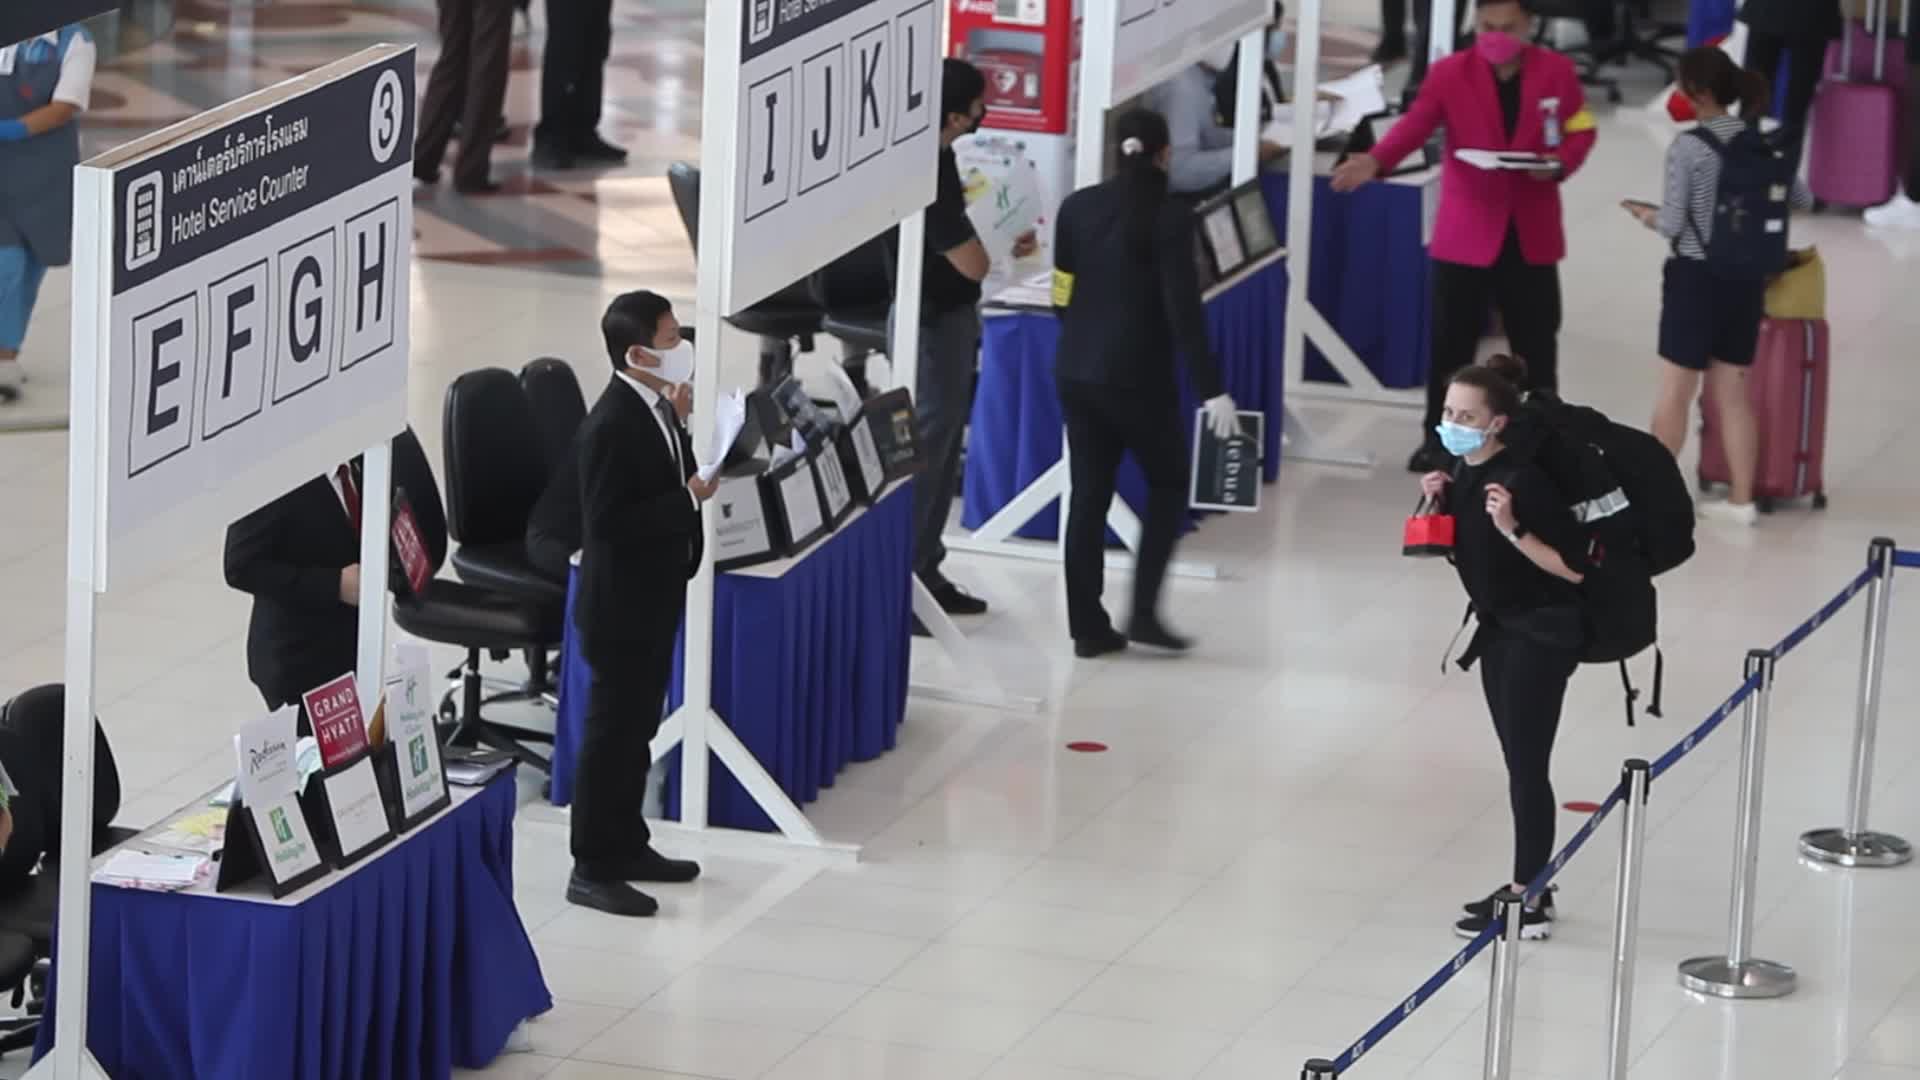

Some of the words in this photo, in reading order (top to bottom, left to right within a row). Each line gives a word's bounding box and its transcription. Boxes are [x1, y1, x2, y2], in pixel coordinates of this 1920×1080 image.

[377, 81, 395, 150] 3
[811, 65, 832, 161] J
[858, 41, 882, 137] K
[906, 25, 924, 112] L
[171, 202, 206, 245] Hotel
[208, 187, 257, 228] Service
[260, 164, 309, 206] Counter
[146, 317, 184, 436] E
[221, 283, 255, 400] F
[288, 255, 323, 363] G
[355, 221, 387, 333] H
[313, 687, 355, 719] GRAND
[321, 713, 359, 745] HYATT
